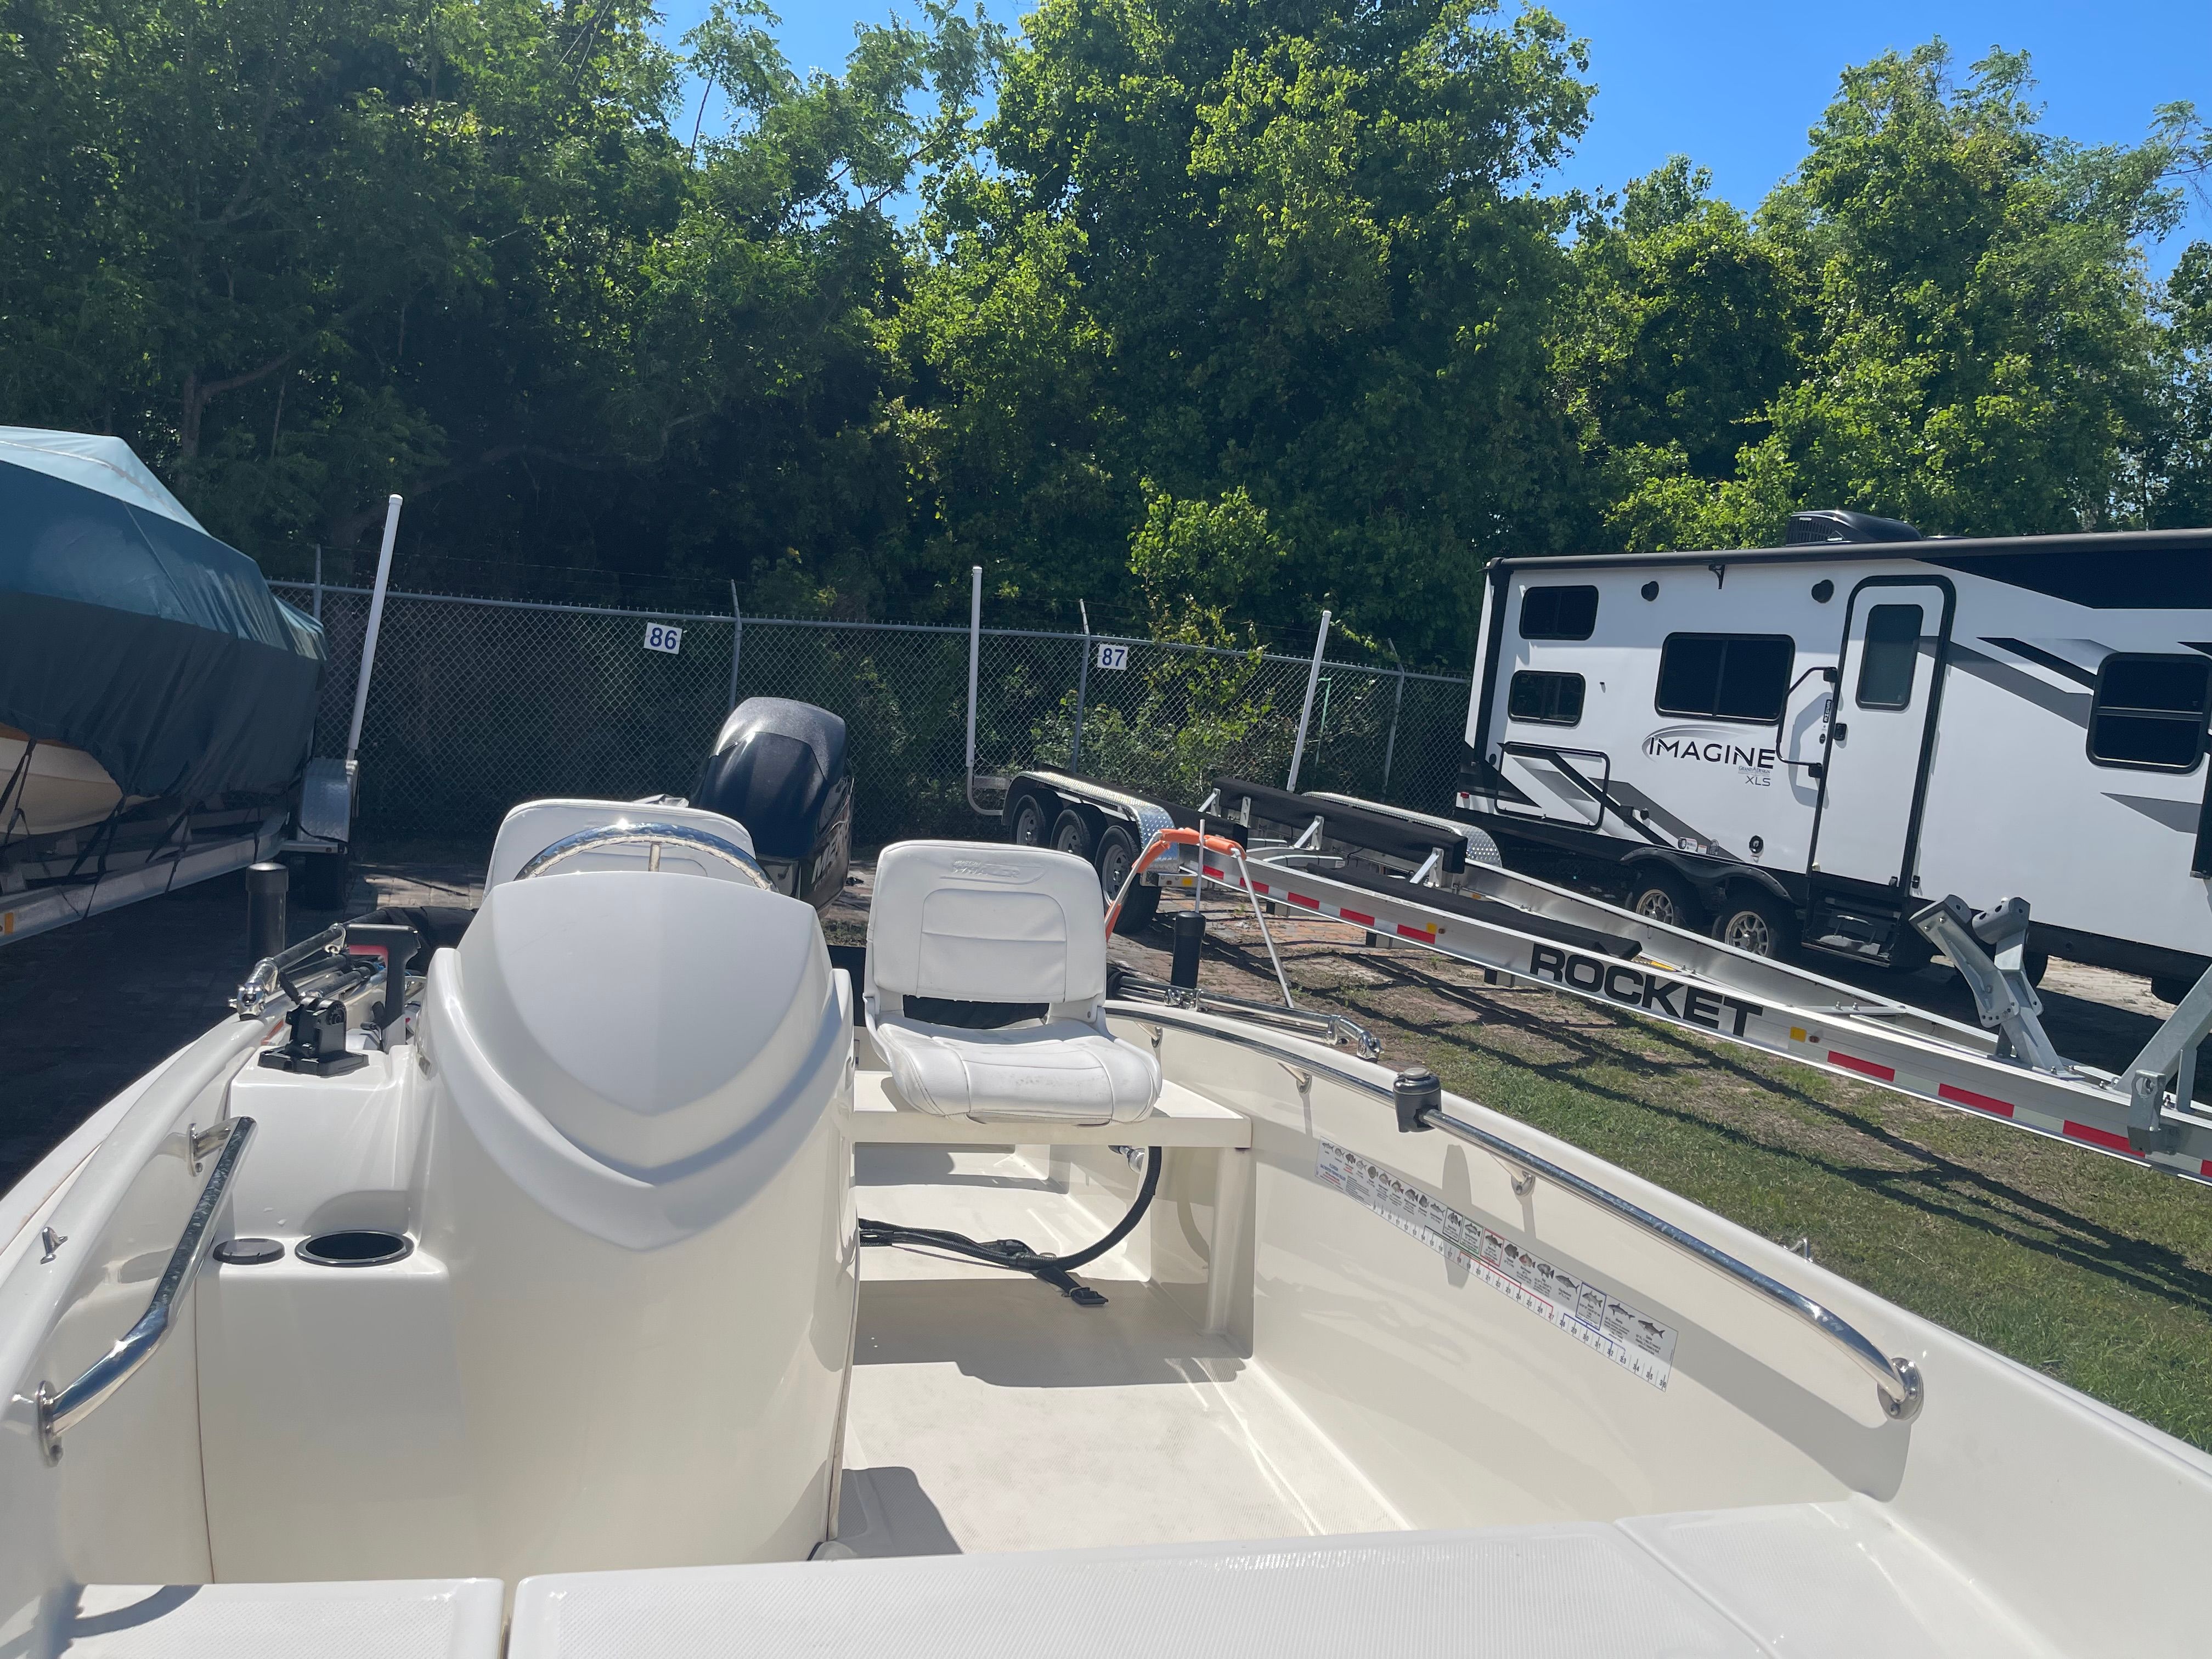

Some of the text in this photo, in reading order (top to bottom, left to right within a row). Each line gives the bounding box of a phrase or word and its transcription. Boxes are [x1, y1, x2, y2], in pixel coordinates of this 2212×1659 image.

[650, 627, 678, 650] 86
[1102, 648, 1125, 667] 87
[1649, 737, 1776, 769] IMAGINE
[1745, 775, 1771, 787] XLS
[1530, 943, 1763, 1038] ROCKET
